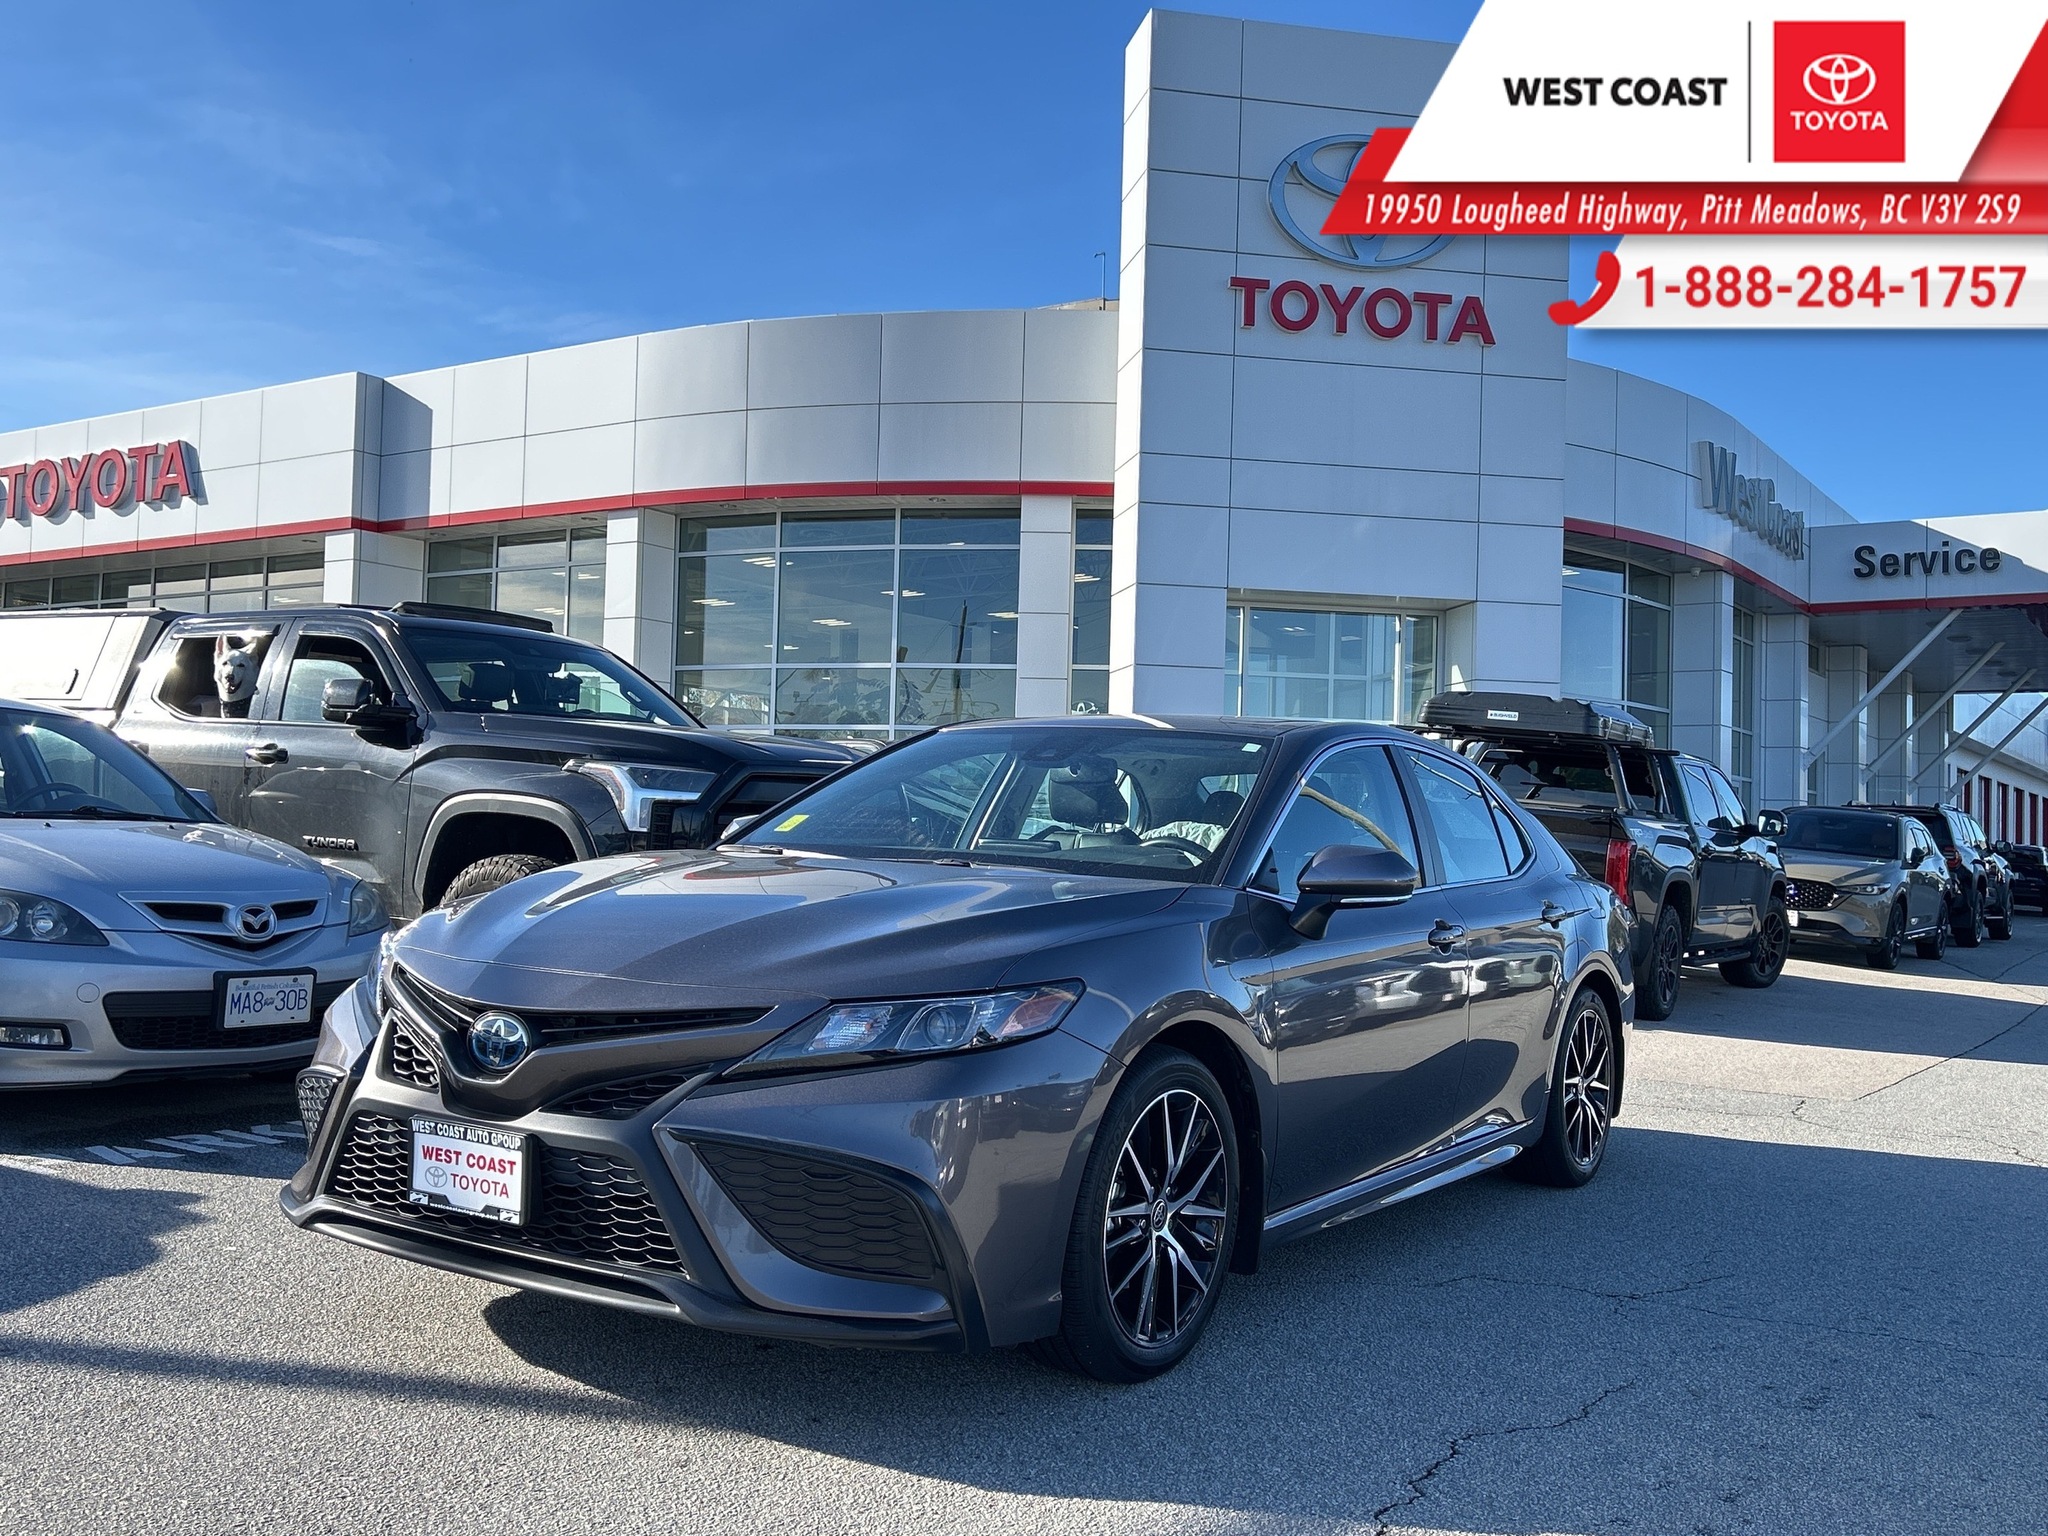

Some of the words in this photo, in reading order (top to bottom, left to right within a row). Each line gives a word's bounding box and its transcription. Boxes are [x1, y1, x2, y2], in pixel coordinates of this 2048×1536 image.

[1228, 275, 1496, 348] TOYOTA
[0, 439, 194, 520] TOYOTA
[1853, 540, 2003, 579] Service
[302, 835, 356, 849] TUNDRA
[411, 1119, 435, 1133] WEST
[437, 1123, 465, 1139] COAST
[467, 1128, 489, 1144] AUTO
[422, 1145, 462, 1165] WEST
[466, 1153, 516, 1175] COAST
[450, 1173, 509, 1198] TOYOTA
